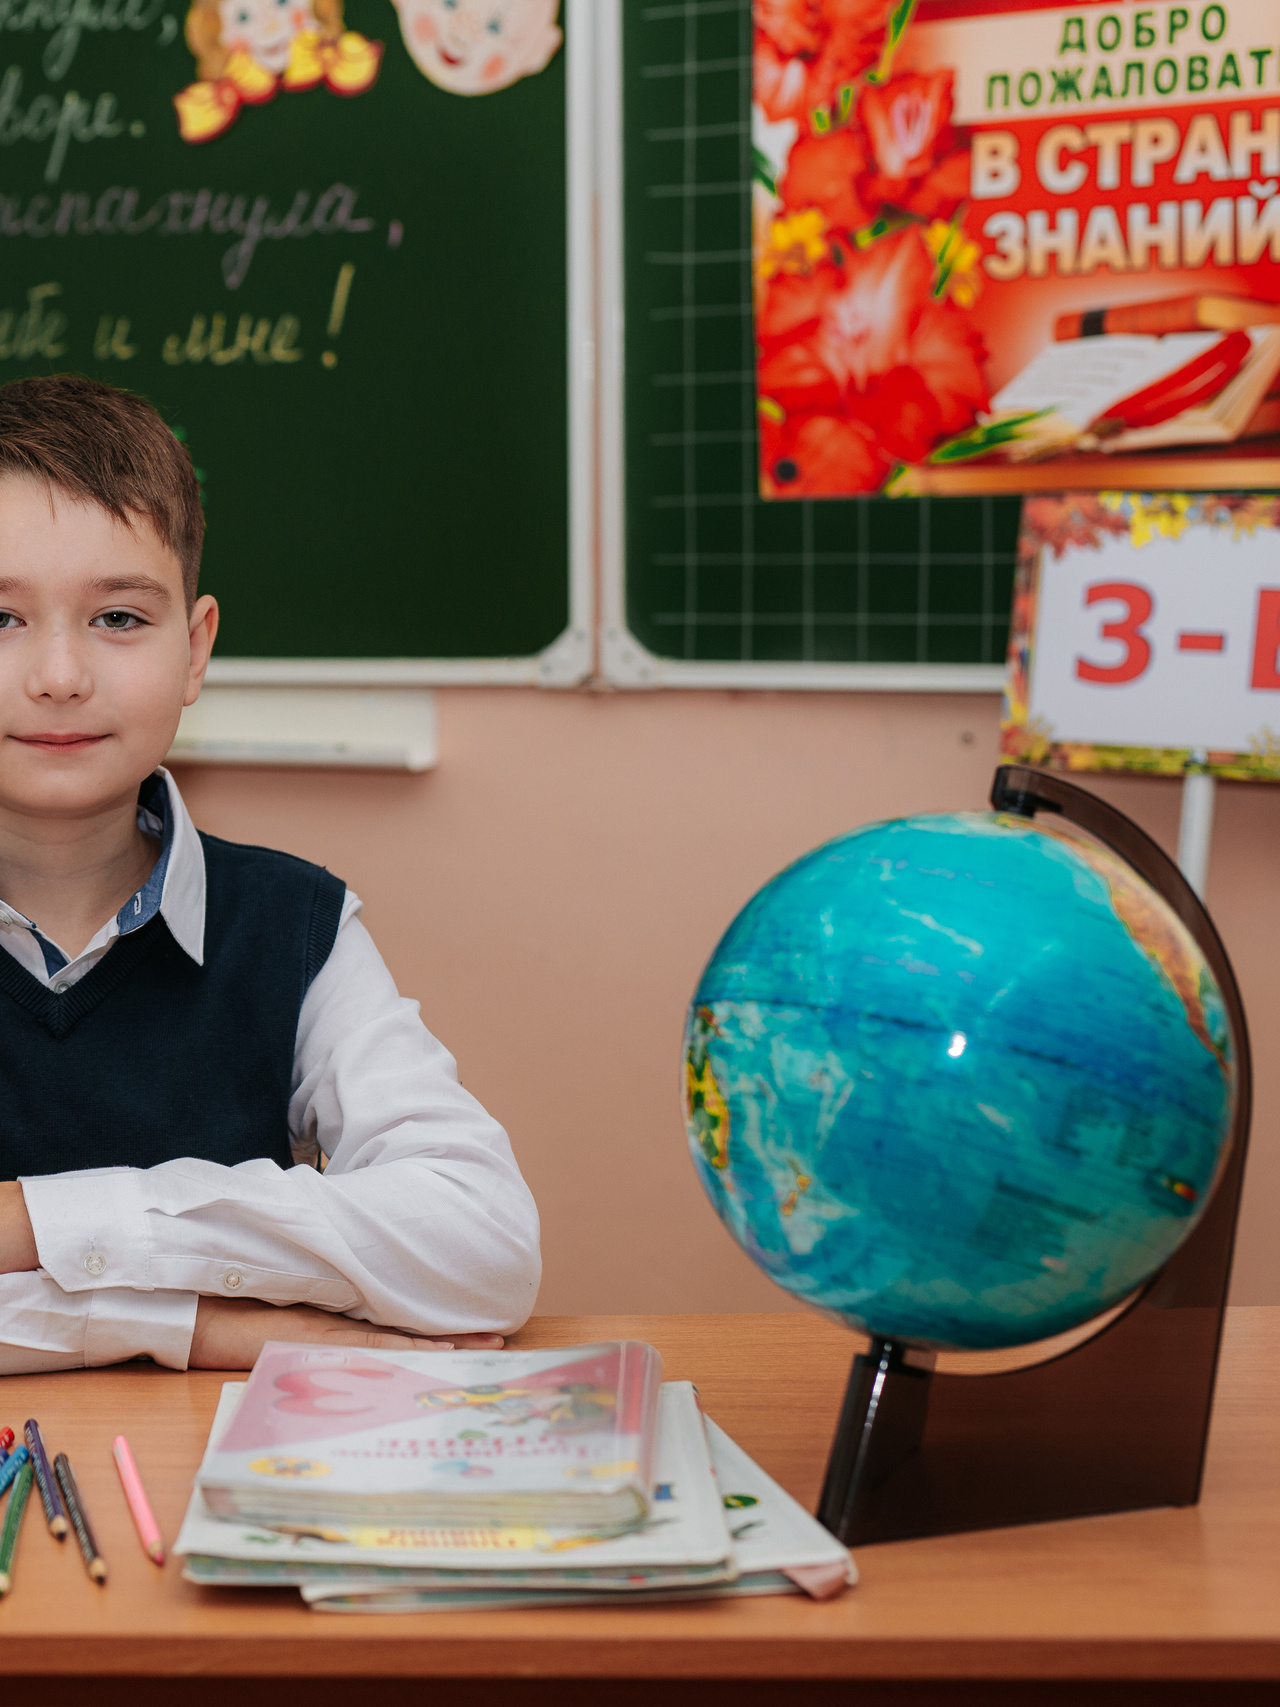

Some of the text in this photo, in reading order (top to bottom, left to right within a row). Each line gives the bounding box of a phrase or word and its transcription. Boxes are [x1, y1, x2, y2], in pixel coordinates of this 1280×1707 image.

[1058, 3, 1228, 55] ДОБРО
[986, 48, 1280, 109] ПОЖАЛОВАТ
[970, 108, 1280, 199] В СТРАН
[981, 180, 1280, 281] ЗНАНИЙ
[94, 311, 142, 361] и
[161, 261, 358, 369] мне!
[273, 1367, 394, 1417] 3
